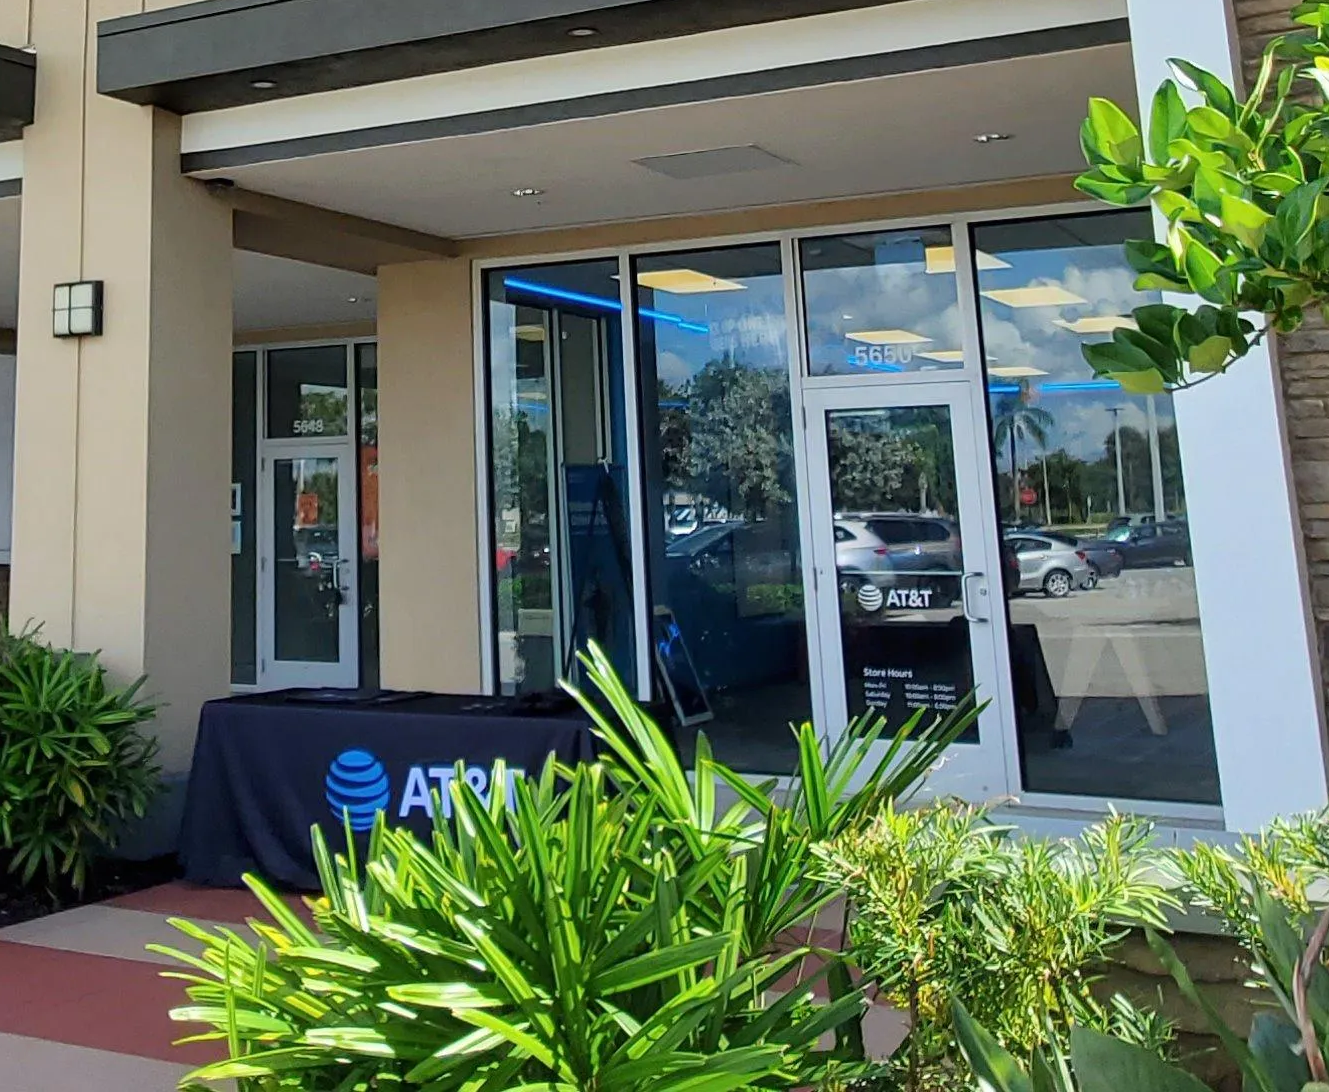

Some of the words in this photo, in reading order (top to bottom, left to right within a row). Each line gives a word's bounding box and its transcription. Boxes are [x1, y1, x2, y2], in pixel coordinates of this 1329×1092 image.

[855, 346, 912, 366] 5650
[886, 589, 932, 608] AT&T
[863, 667, 886, 678] Store
[888, 668, 913, 678] Hours
[865, 690, 890, 698] Saturday
[866, 700, 887, 708] Sunday
